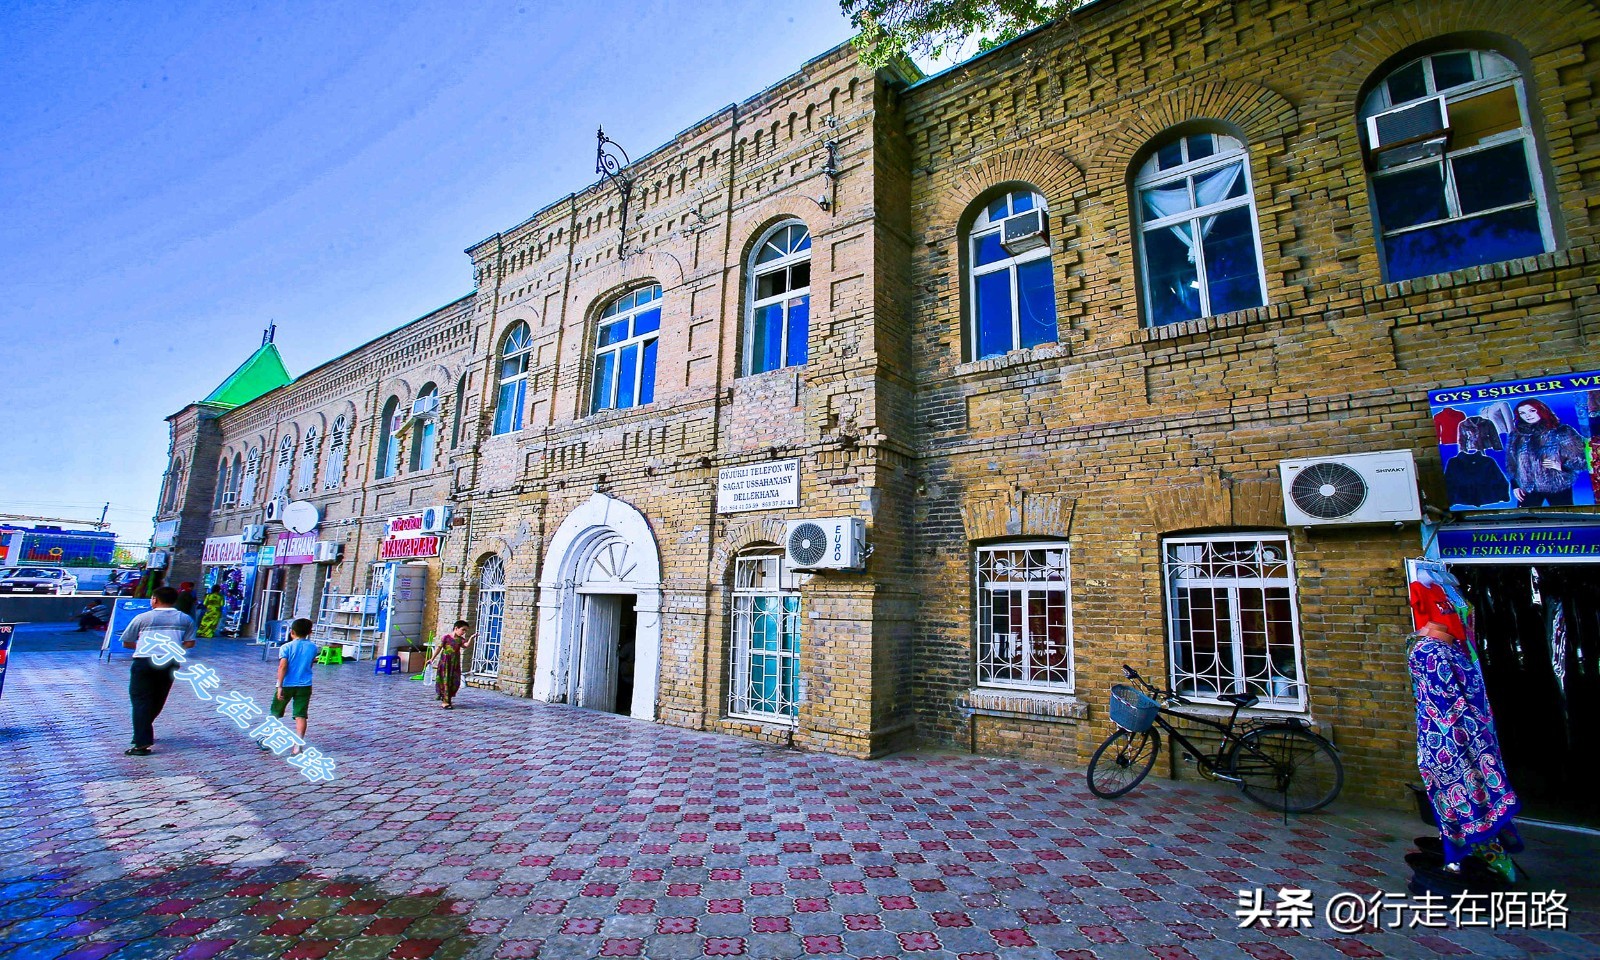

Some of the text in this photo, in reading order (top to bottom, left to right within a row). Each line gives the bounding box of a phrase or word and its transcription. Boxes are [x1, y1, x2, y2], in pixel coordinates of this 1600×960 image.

[1434, 390, 1472, 402] GYŞ
[1477, 380, 1564, 399] EŞIKLER
[750, 464, 783, 477] TELEFON
[784, 462, 796, 472] WE
[1375, 466, 1406, 474] SHIVAKY
[722, 475, 793, 492] SAGAT USSAHANASY
[733, 489, 780, 502] DELLEKHANA
[1530, 530, 1573, 542] HILLI
[834, 525, 842, 562] EURO
[1442, 546, 1468, 557] GYŞ
[1471, 544, 1531, 557] EŞIKLER
